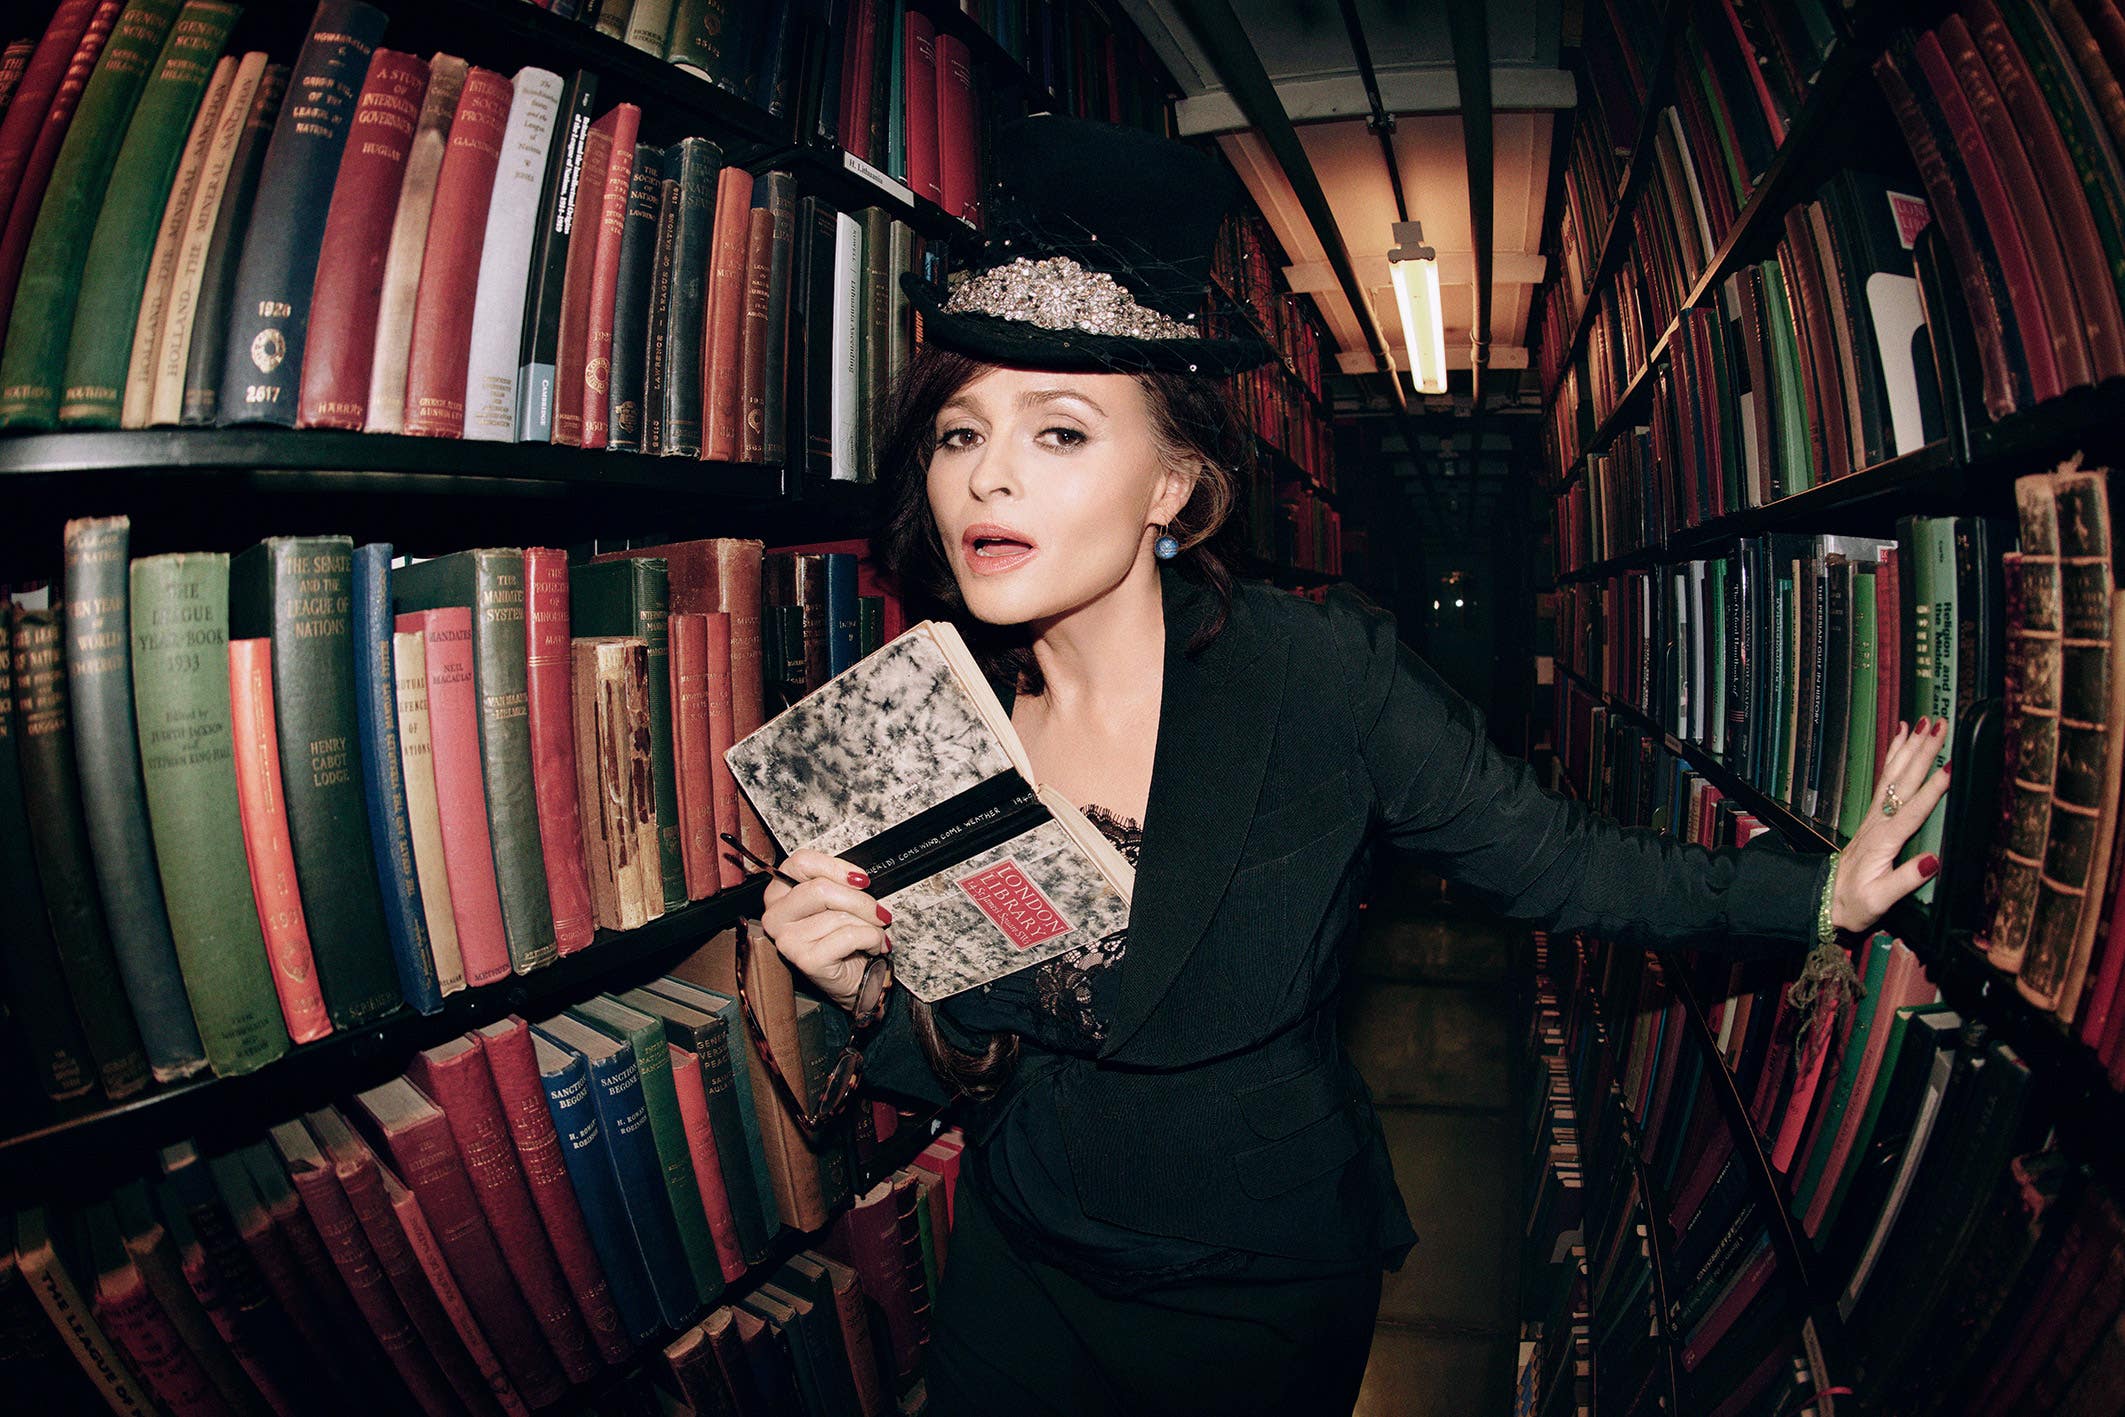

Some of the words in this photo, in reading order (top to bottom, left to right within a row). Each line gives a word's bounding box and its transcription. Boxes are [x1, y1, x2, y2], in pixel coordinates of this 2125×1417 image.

[286, 556, 309, 576] THE
[299, 578, 320, 593] AND
[287, 597, 332, 619] LEAGUE
[336, 597, 349, 612] OF
[294, 618, 345, 639] NATIONS
[1941, 602, 1953, 658] Religion
[1816, 672, 1823, 684] IN
[1942, 664, 1952, 692] and
[1814, 685, 1822, 725] HISTORY
[310, 736, 347, 755] HENRY
[312, 752, 347, 772] CABOT
[898, 847, 920, 862] COME
[941, 825, 963, 840] COME
[963, 806, 1001, 827] WEATHER
[980, 873, 1048, 937] LIBRARY
[997, 866, 1065, 933] LONDON
[42, 1269, 71, 1312] THE
[66, 1313, 118, 1384] LEAGUE
